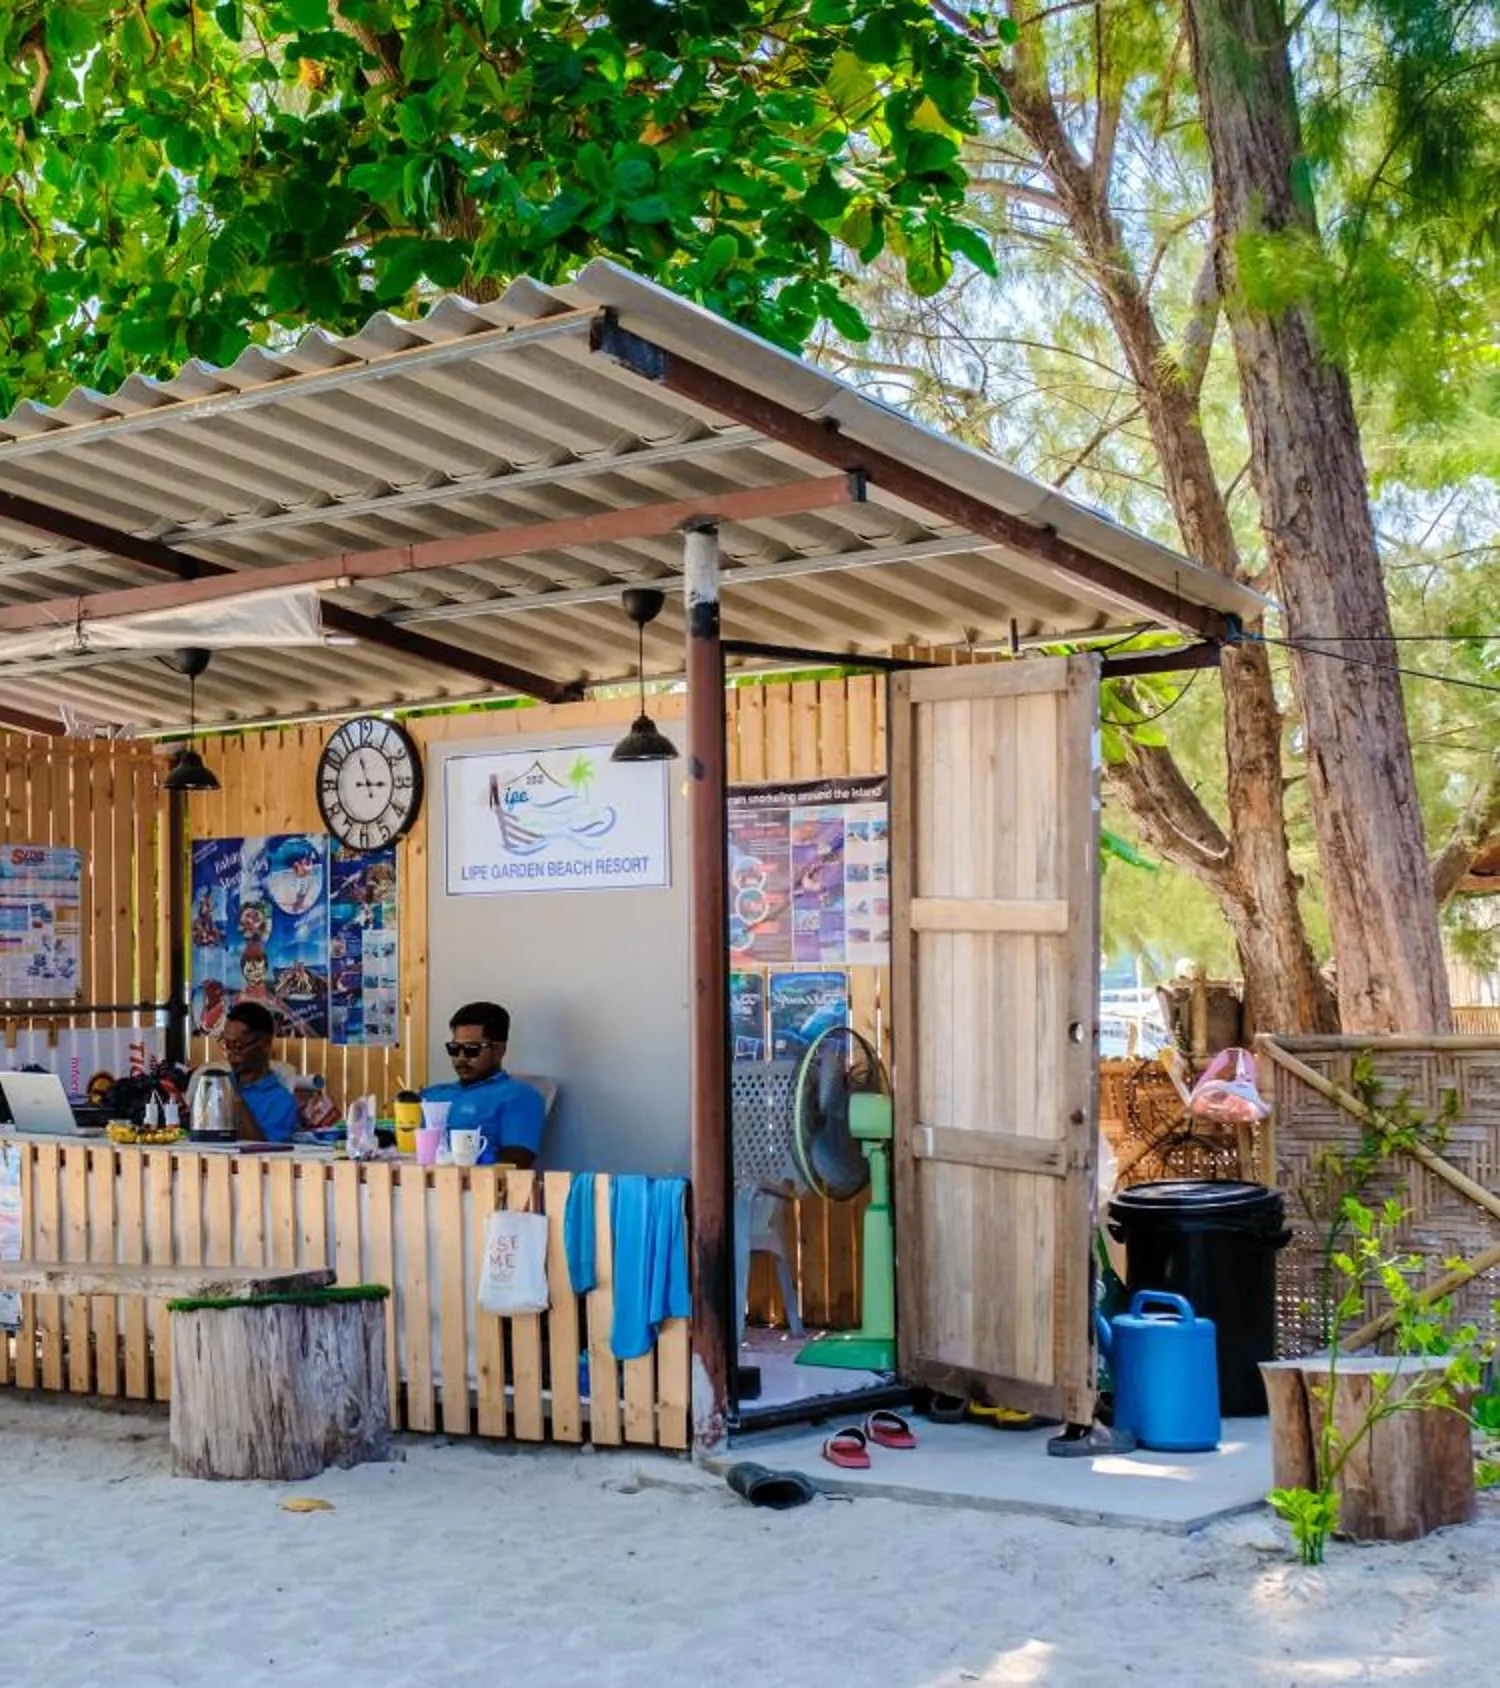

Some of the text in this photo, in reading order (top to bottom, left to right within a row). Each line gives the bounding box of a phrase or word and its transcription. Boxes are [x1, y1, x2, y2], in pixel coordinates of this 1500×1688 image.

[340, 727, 355, 753] 11
[360, 720, 373, 747] 12
[380, 727, 391, 749] 1
[325, 747, 344, 772] 10
[798, 788, 832, 801] around
[833, 787, 850, 798] the
[461, 856, 649, 881] LIPE GARDEN BEACH RESORT
[490, 1253, 516, 1269] ME
